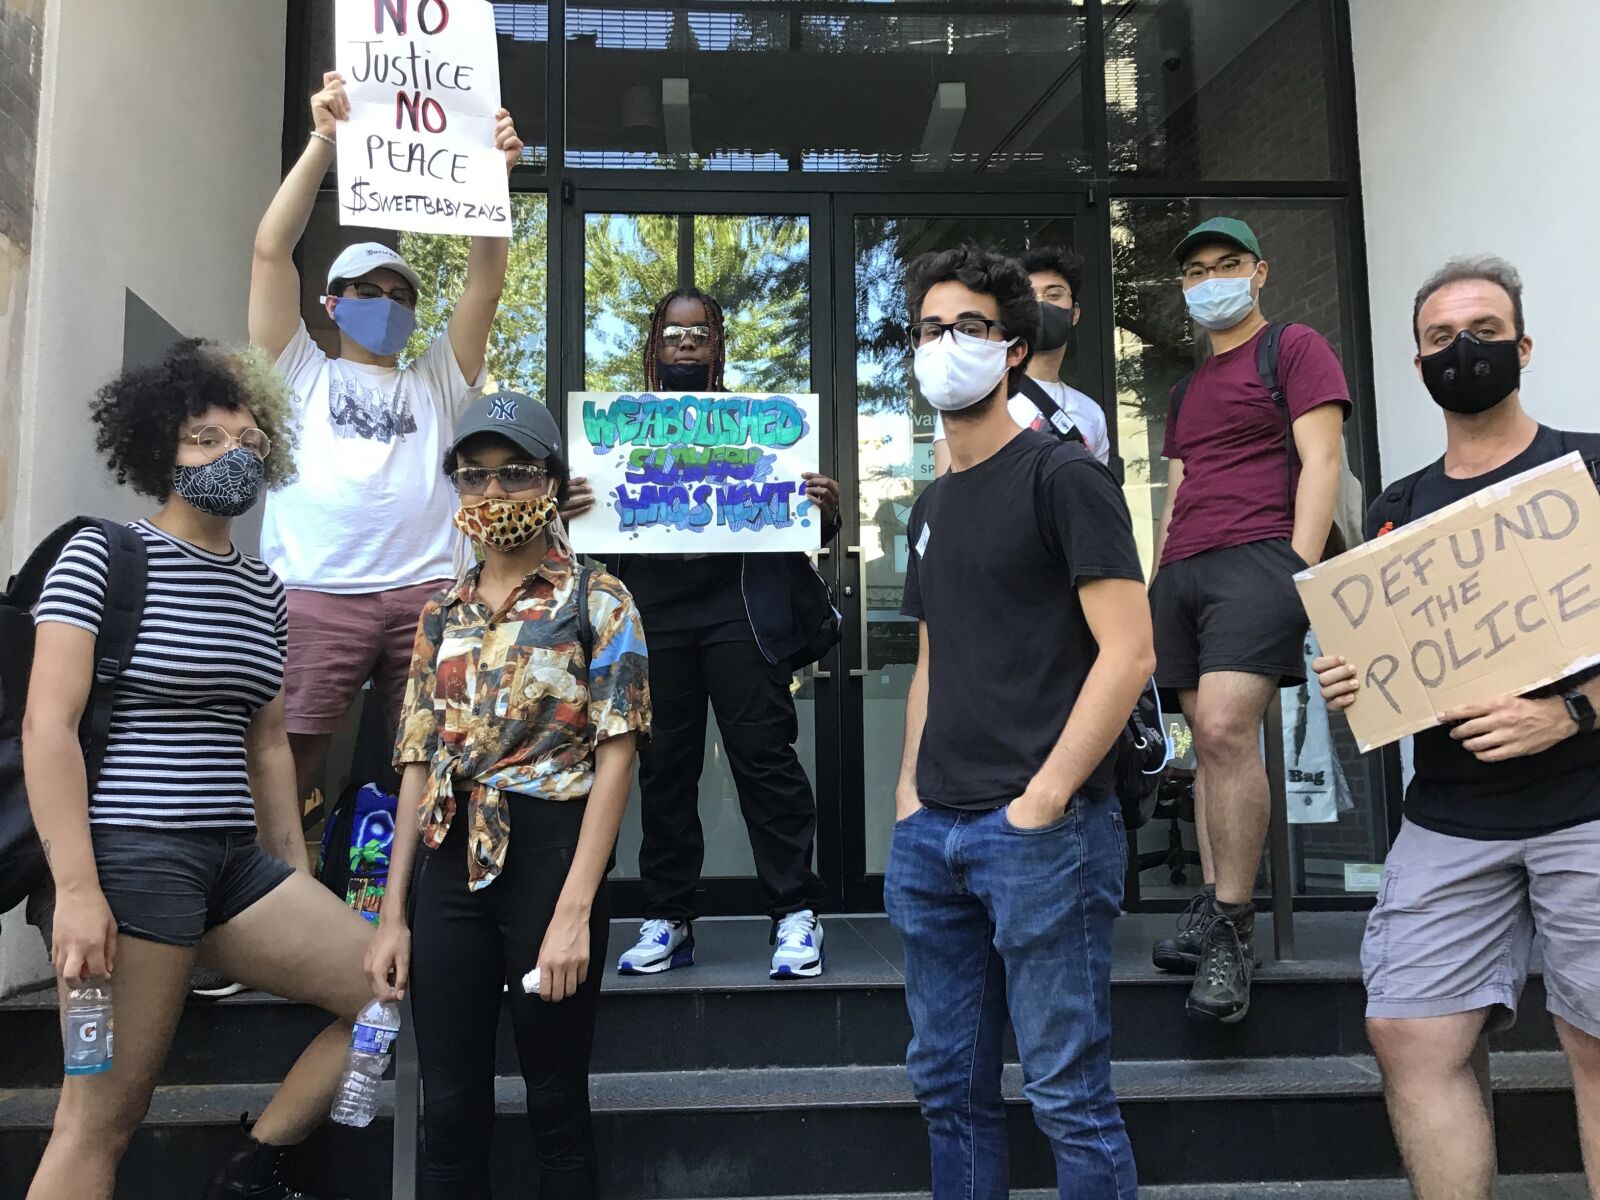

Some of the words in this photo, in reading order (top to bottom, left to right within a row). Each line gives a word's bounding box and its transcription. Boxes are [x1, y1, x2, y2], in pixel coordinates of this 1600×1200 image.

[374, 0, 449, 36] NO
[395, 90, 447, 134] NO
[366, 135, 469, 184] PEACE
[487, 398, 519, 421] NY
[1330, 489, 1580, 629] DEFUND
[1411, 571, 1481, 627] THE
[1365, 563, 1600, 715] POLICE
[1288, 770, 1325, 786] Bag
